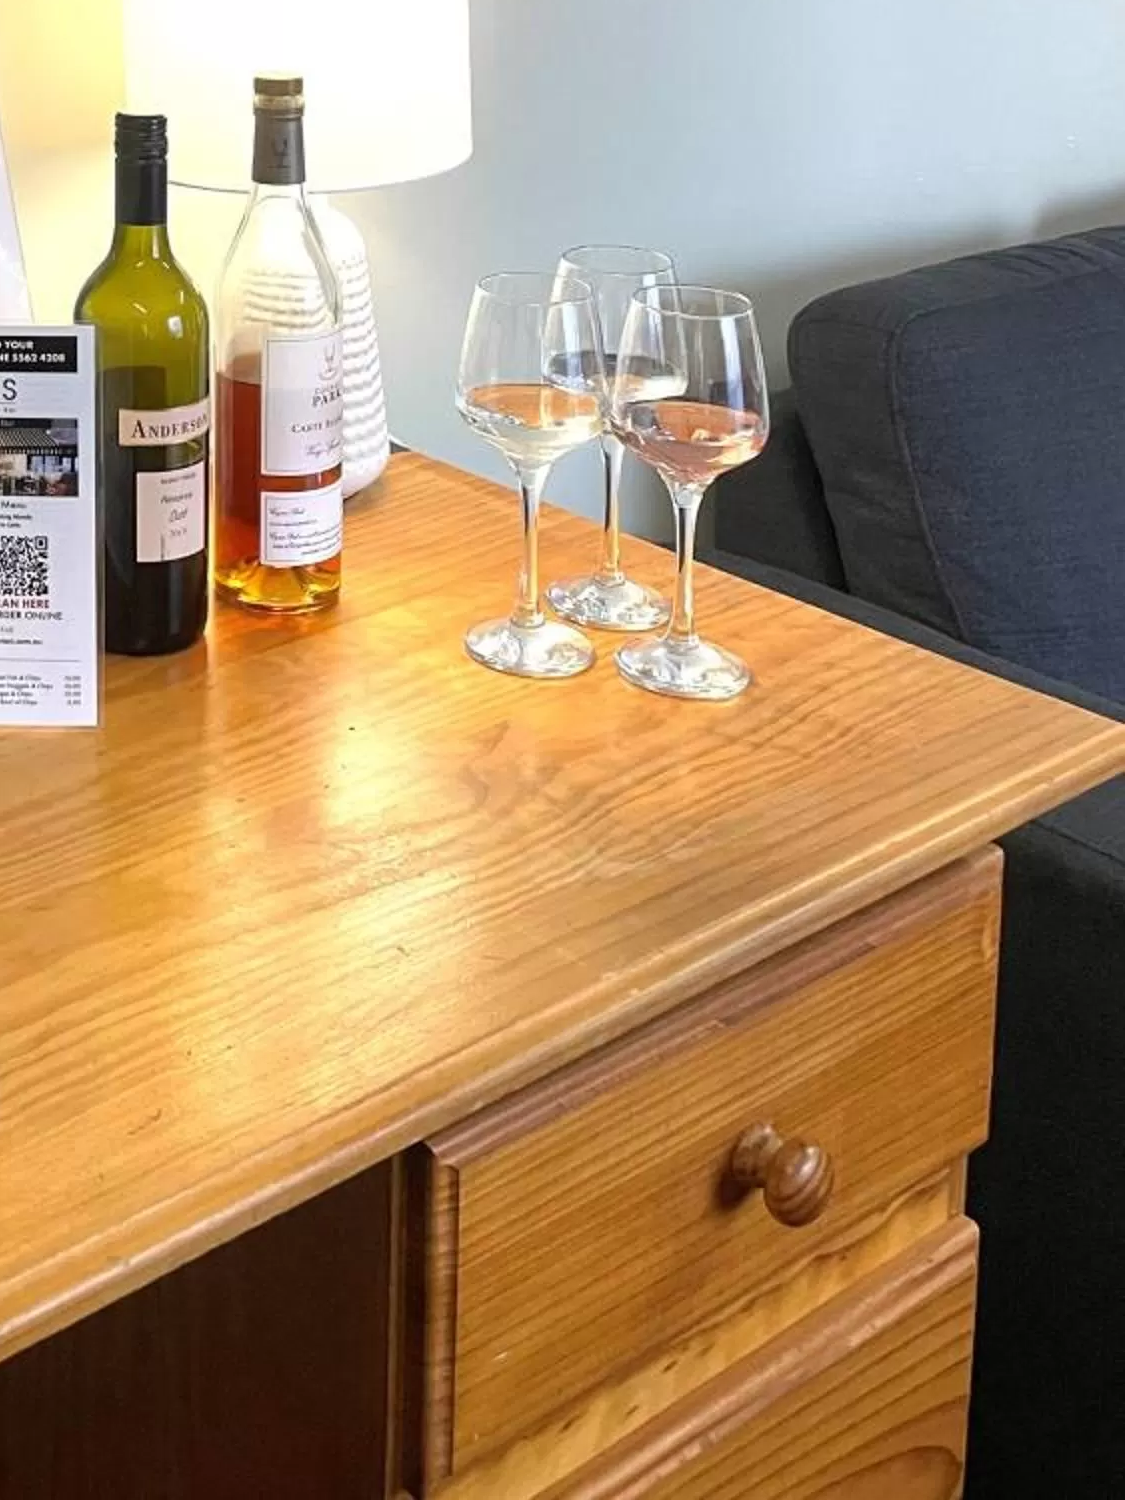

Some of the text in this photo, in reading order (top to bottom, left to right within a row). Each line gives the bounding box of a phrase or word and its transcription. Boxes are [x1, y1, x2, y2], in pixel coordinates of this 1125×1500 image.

[4, 340, 34, 350] YOUR
[22, 599, 50, 609] HERE
[24, 611, 63, 620] ONLINE
